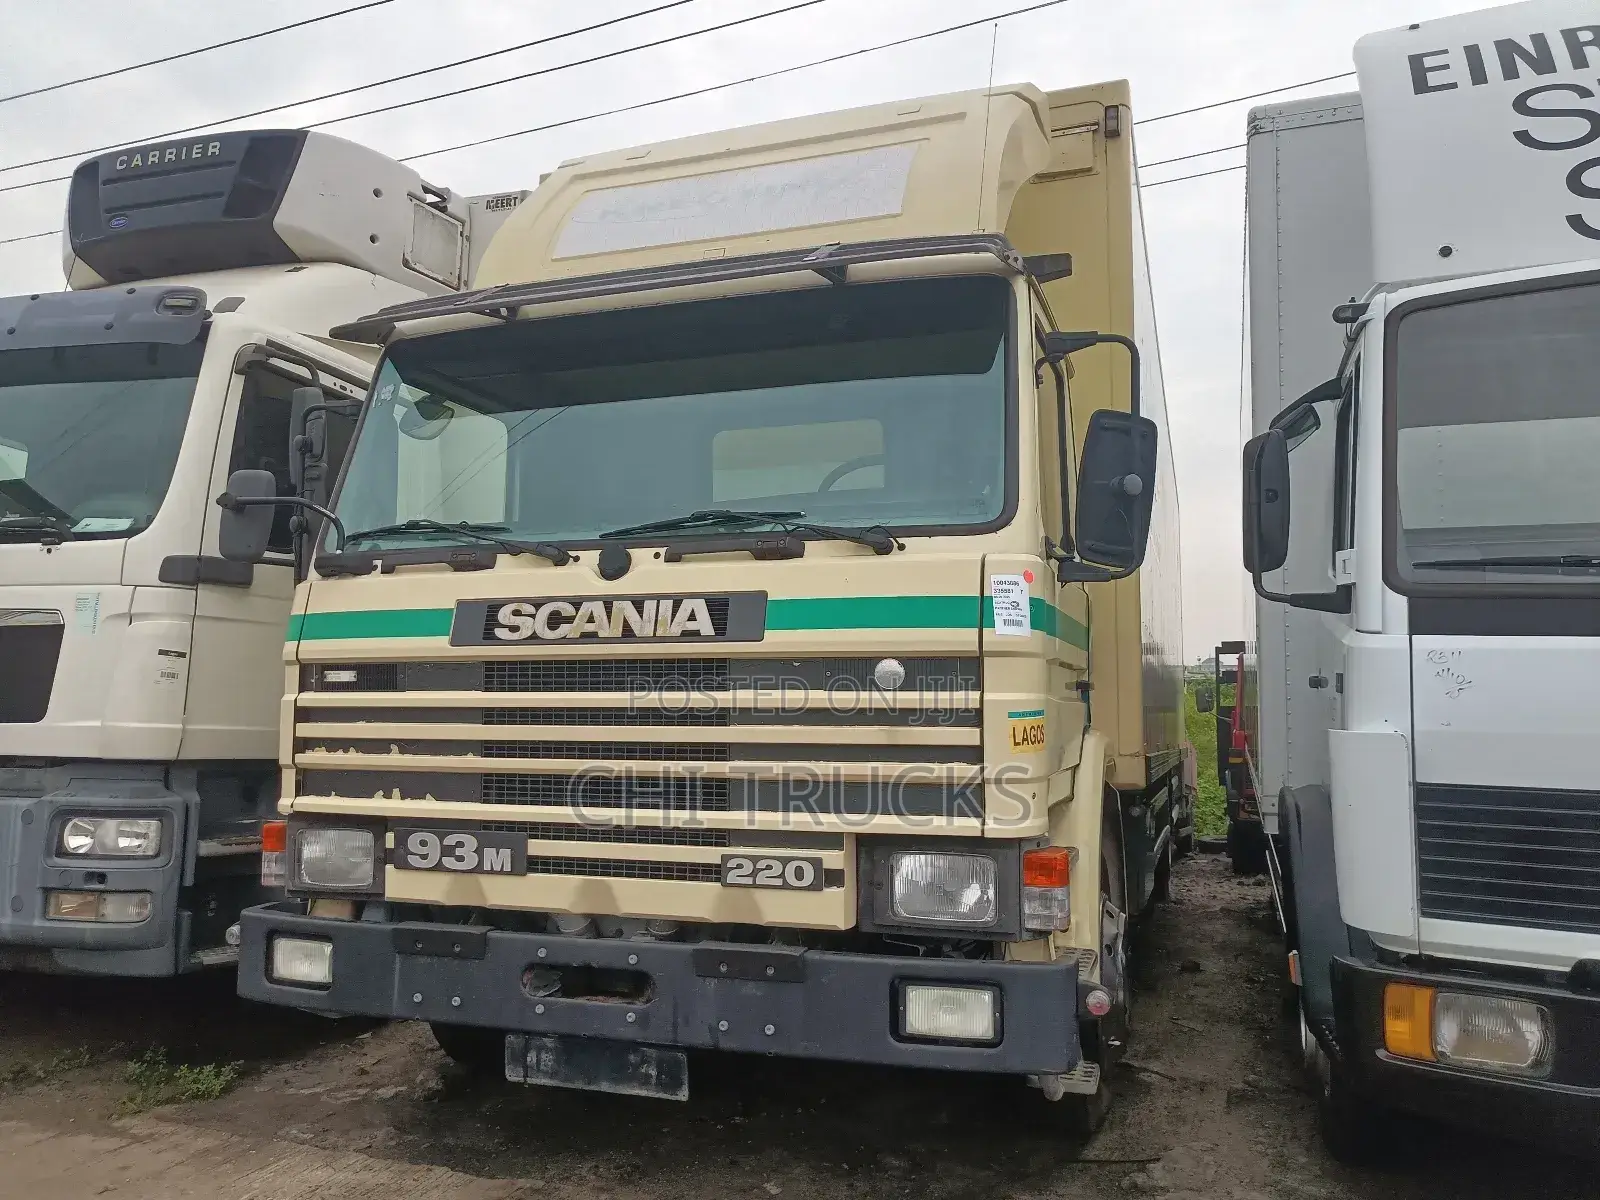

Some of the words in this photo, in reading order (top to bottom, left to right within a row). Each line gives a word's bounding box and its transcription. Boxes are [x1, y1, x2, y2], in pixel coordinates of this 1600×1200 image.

[1512, 77, 1600, 151] S
[116, 141, 221, 170] CARRIER
[486, 196, 518, 210] MEERT
[494, 598, 715, 641] SCANIA
[1012, 724, 1045, 746] LAGOS
[726, 857, 815, 887] 220
